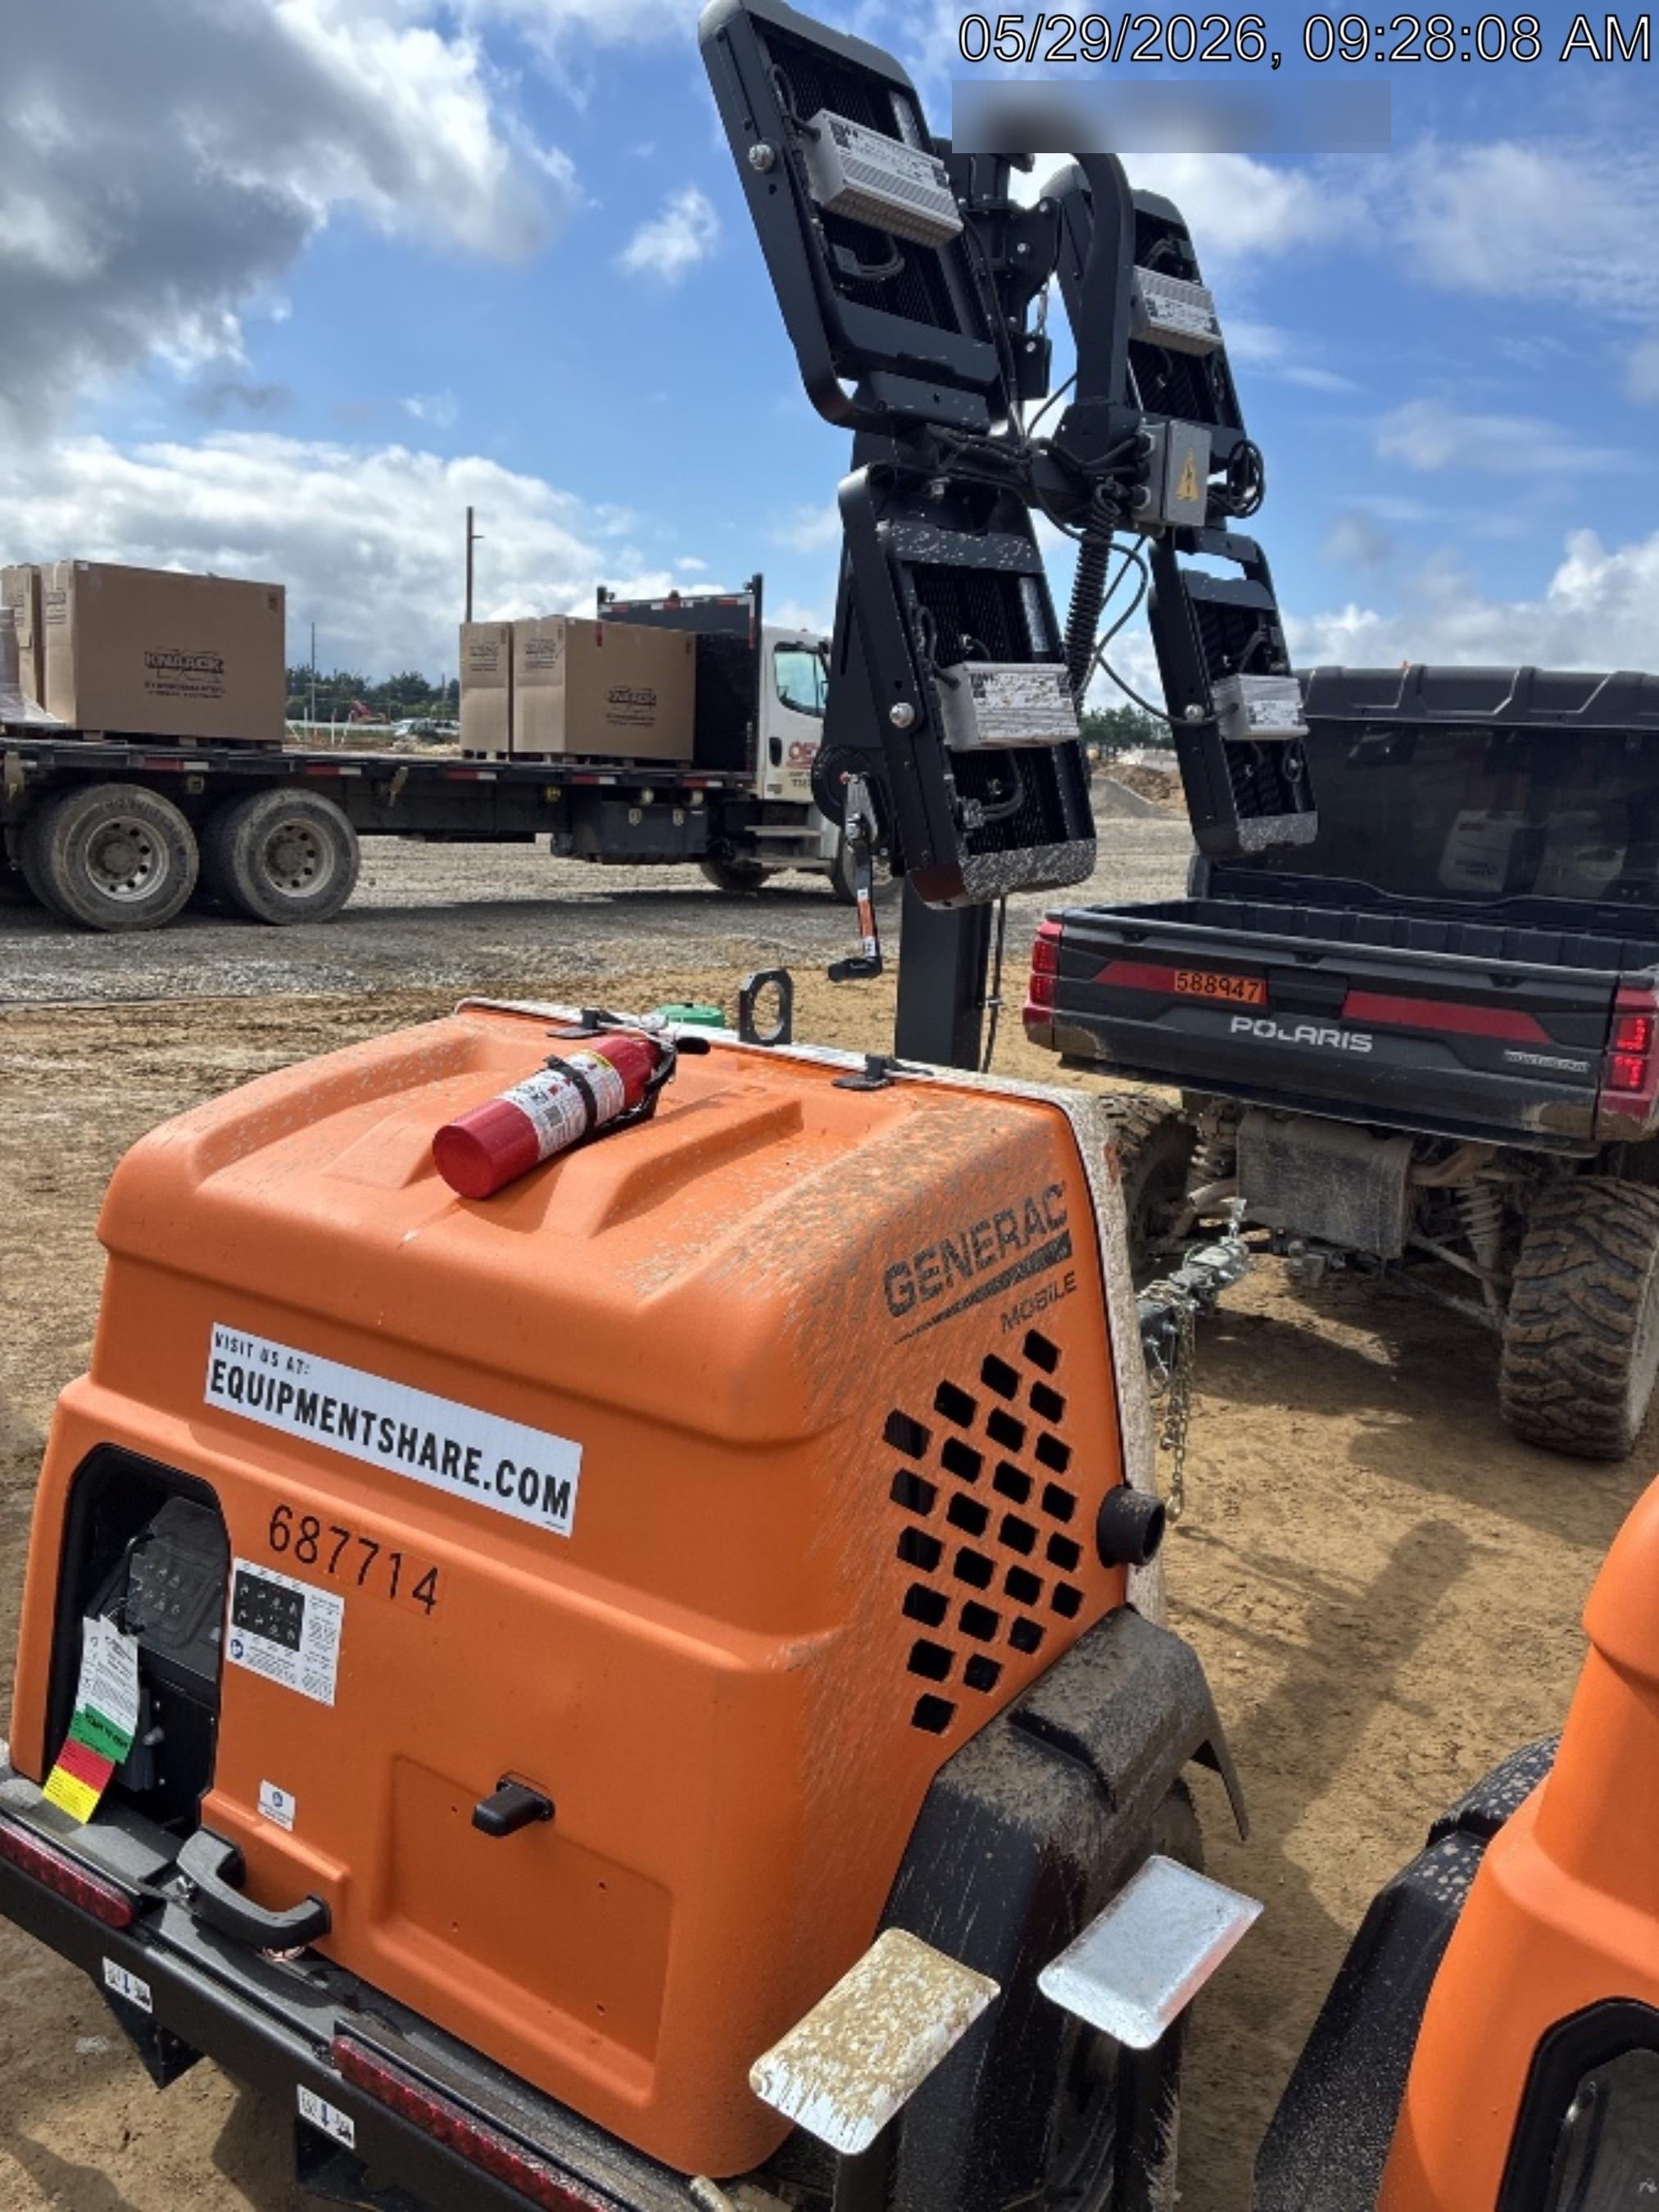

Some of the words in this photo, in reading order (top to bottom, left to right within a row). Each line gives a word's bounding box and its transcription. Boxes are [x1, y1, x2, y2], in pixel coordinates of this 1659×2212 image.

[1176, 972, 1260, 1002] 588947
[1231, 1016, 1373, 1054] POLARIS
[883, 1183, 1068, 1318] GENERAC
[999, 1271, 1077, 1335] MOBILE
[215, 1330, 254, 1358] VISIT
[260, 1346, 279, 1368] US
[287, 1356, 311, 1376] AT:
[210, 1358, 572, 1520] EQUIPMENTSHARE.COM
[269, 1503, 439, 1616] 687714
